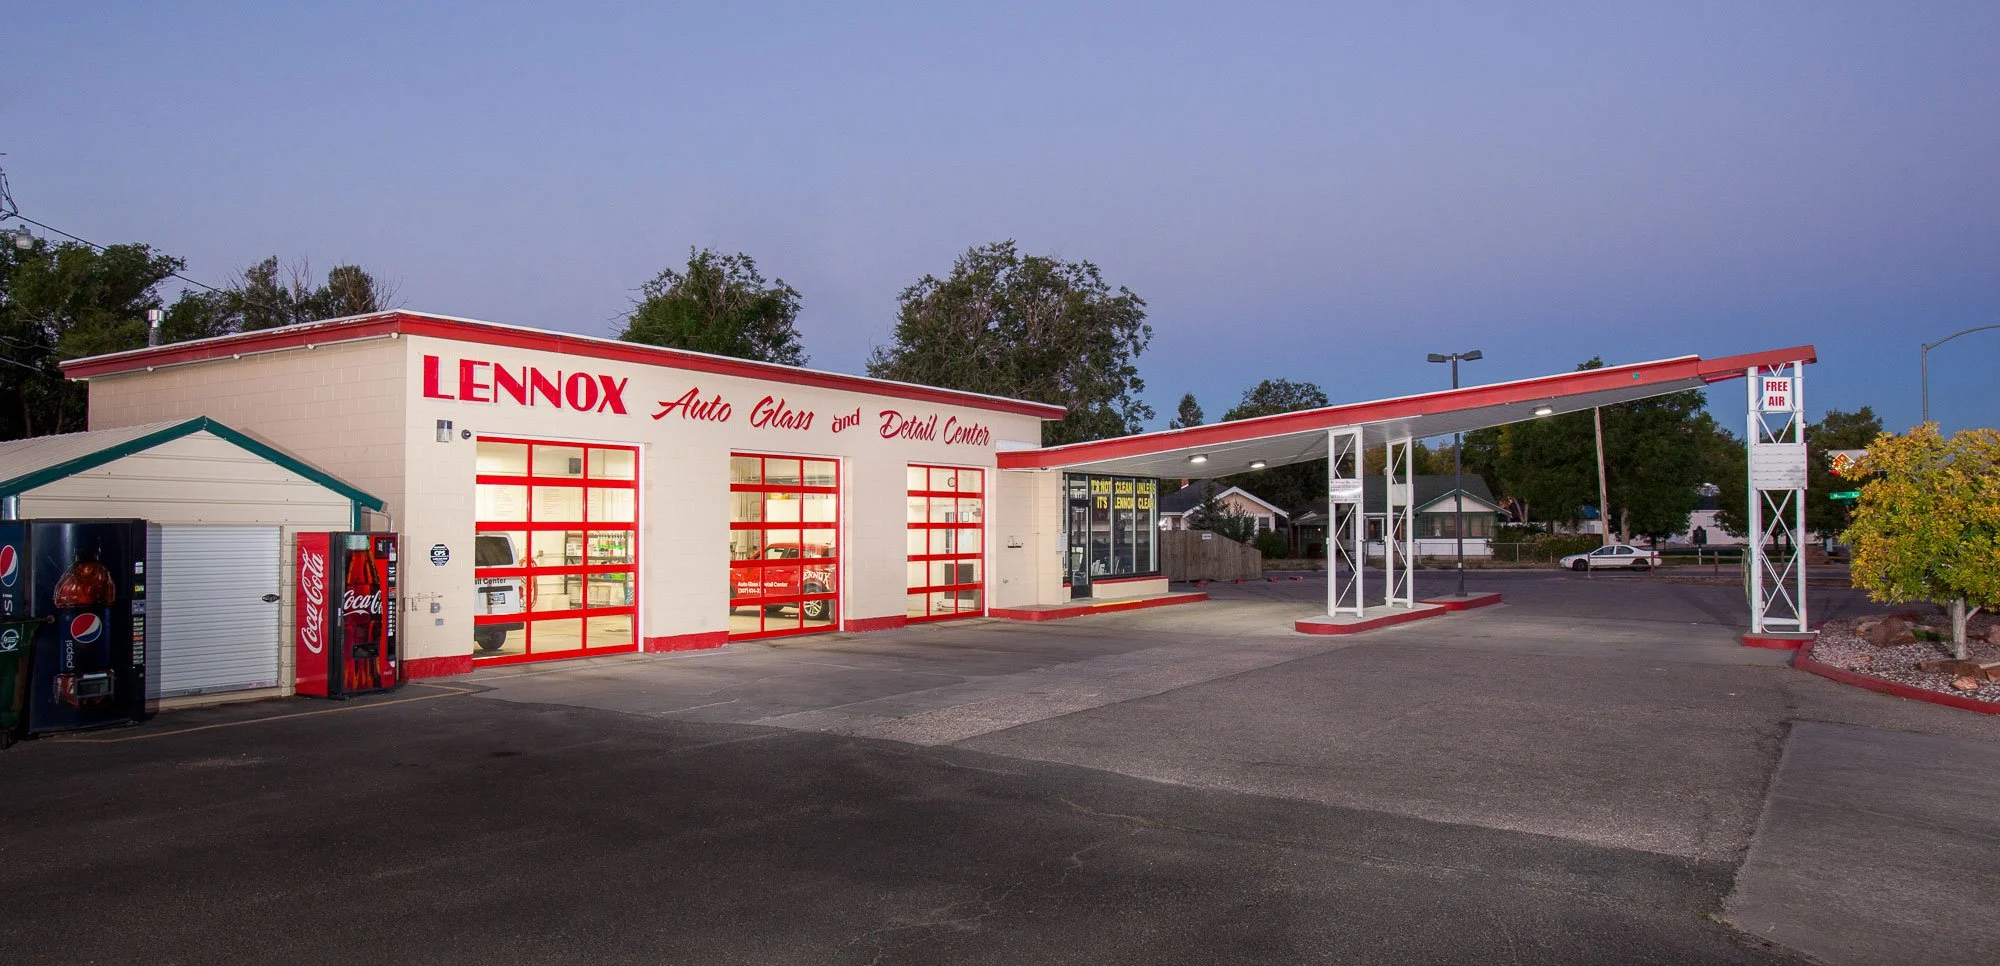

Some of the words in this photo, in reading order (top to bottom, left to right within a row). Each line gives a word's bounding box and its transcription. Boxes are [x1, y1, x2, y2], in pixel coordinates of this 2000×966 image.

[1766, 381, 1788, 392] FREE
[423, 354, 629, 415] LENNOX
[651, 386, 732, 423] Auto
[750, 395, 815, 431] Glass
[832, 407, 860, 433] and
[879, 409, 938, 442] Detail
[943, 416, 991, 447] Center
[1768, 396, 1785, 406] AIR
[1115, 482, 1132, 494] CLEAN
[1097, 496, 1107, 509] IT'S
[483, 577, 507, 585] Center
[803, 569, 831, 590] ENNOX
[301, 546, 324, 654] Coca-Cola
[65, 640, 75, 669] pepsi
